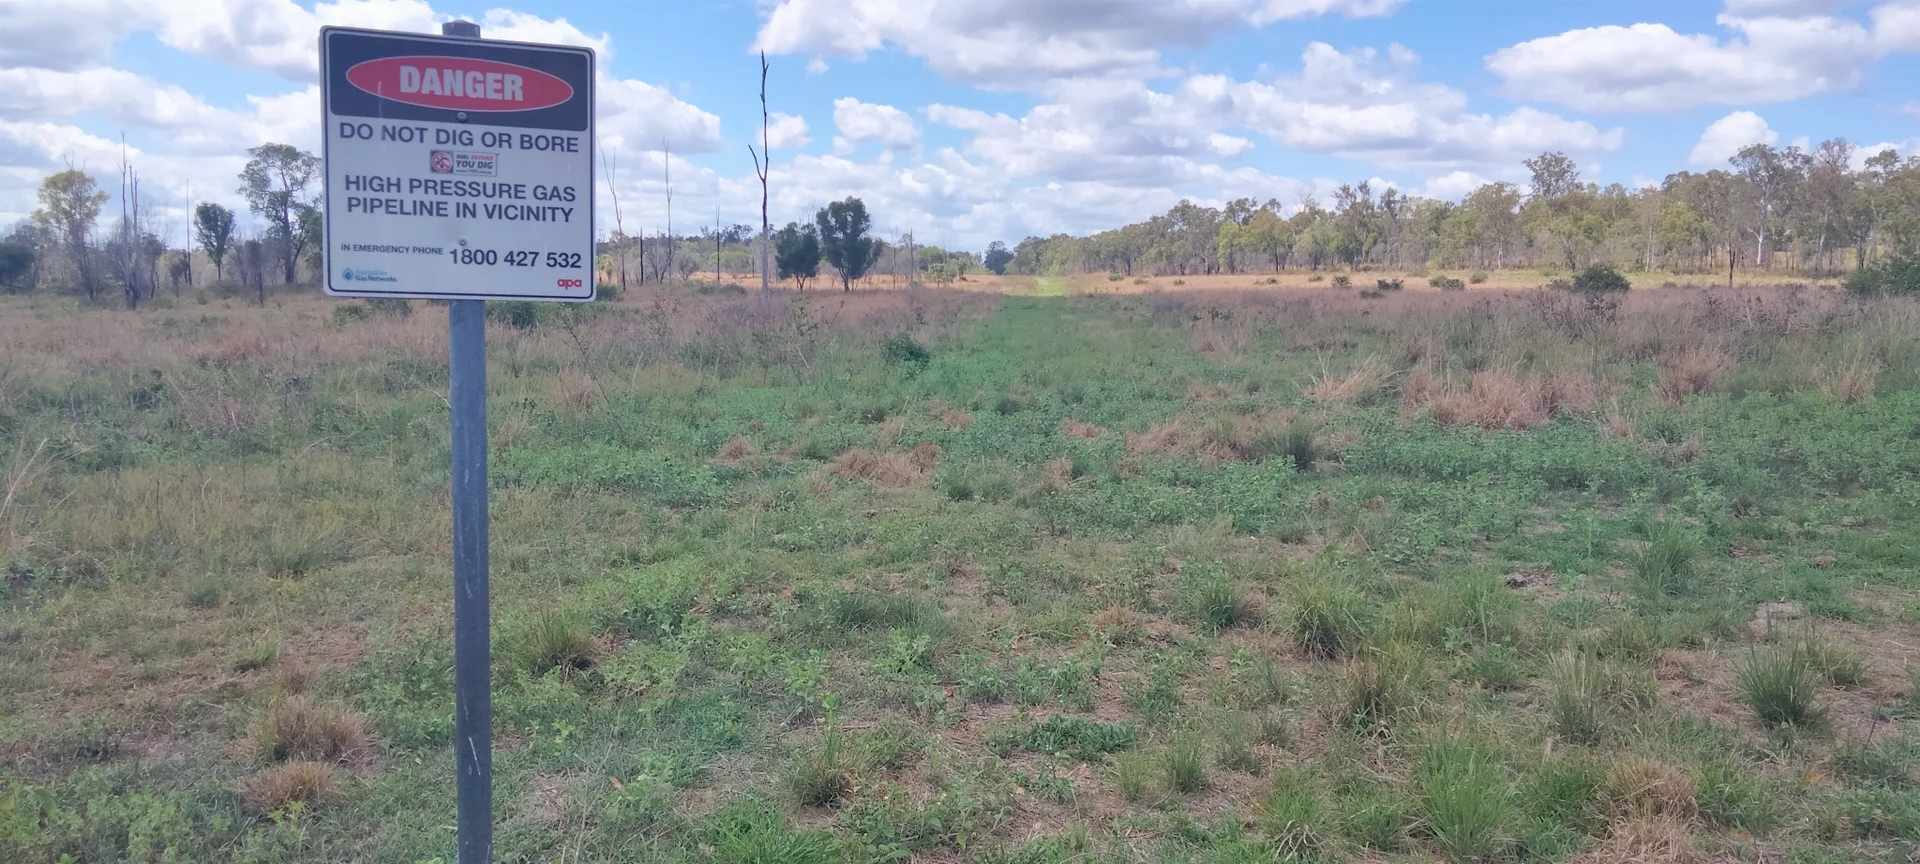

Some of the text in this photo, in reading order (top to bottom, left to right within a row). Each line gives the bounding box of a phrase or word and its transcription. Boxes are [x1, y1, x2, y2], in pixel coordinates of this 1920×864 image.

[400, 65, 523, 101] DANGER
[340, 122, 578, 152] DO NOT DIG OR BORE
[345, 175, 576, 202] HIGH PRESSURE GAS
[348, 197, 574, 222] PIPELINE IN VICINITY
[353, 244, 410, 254] EMERGENCY
[413, 246, 443, 255] PHONE
[450, 249, 581, 268] 1800 427 532
[368, 275, 397, 283] Networks
[557, 278, 582, 290] apa
